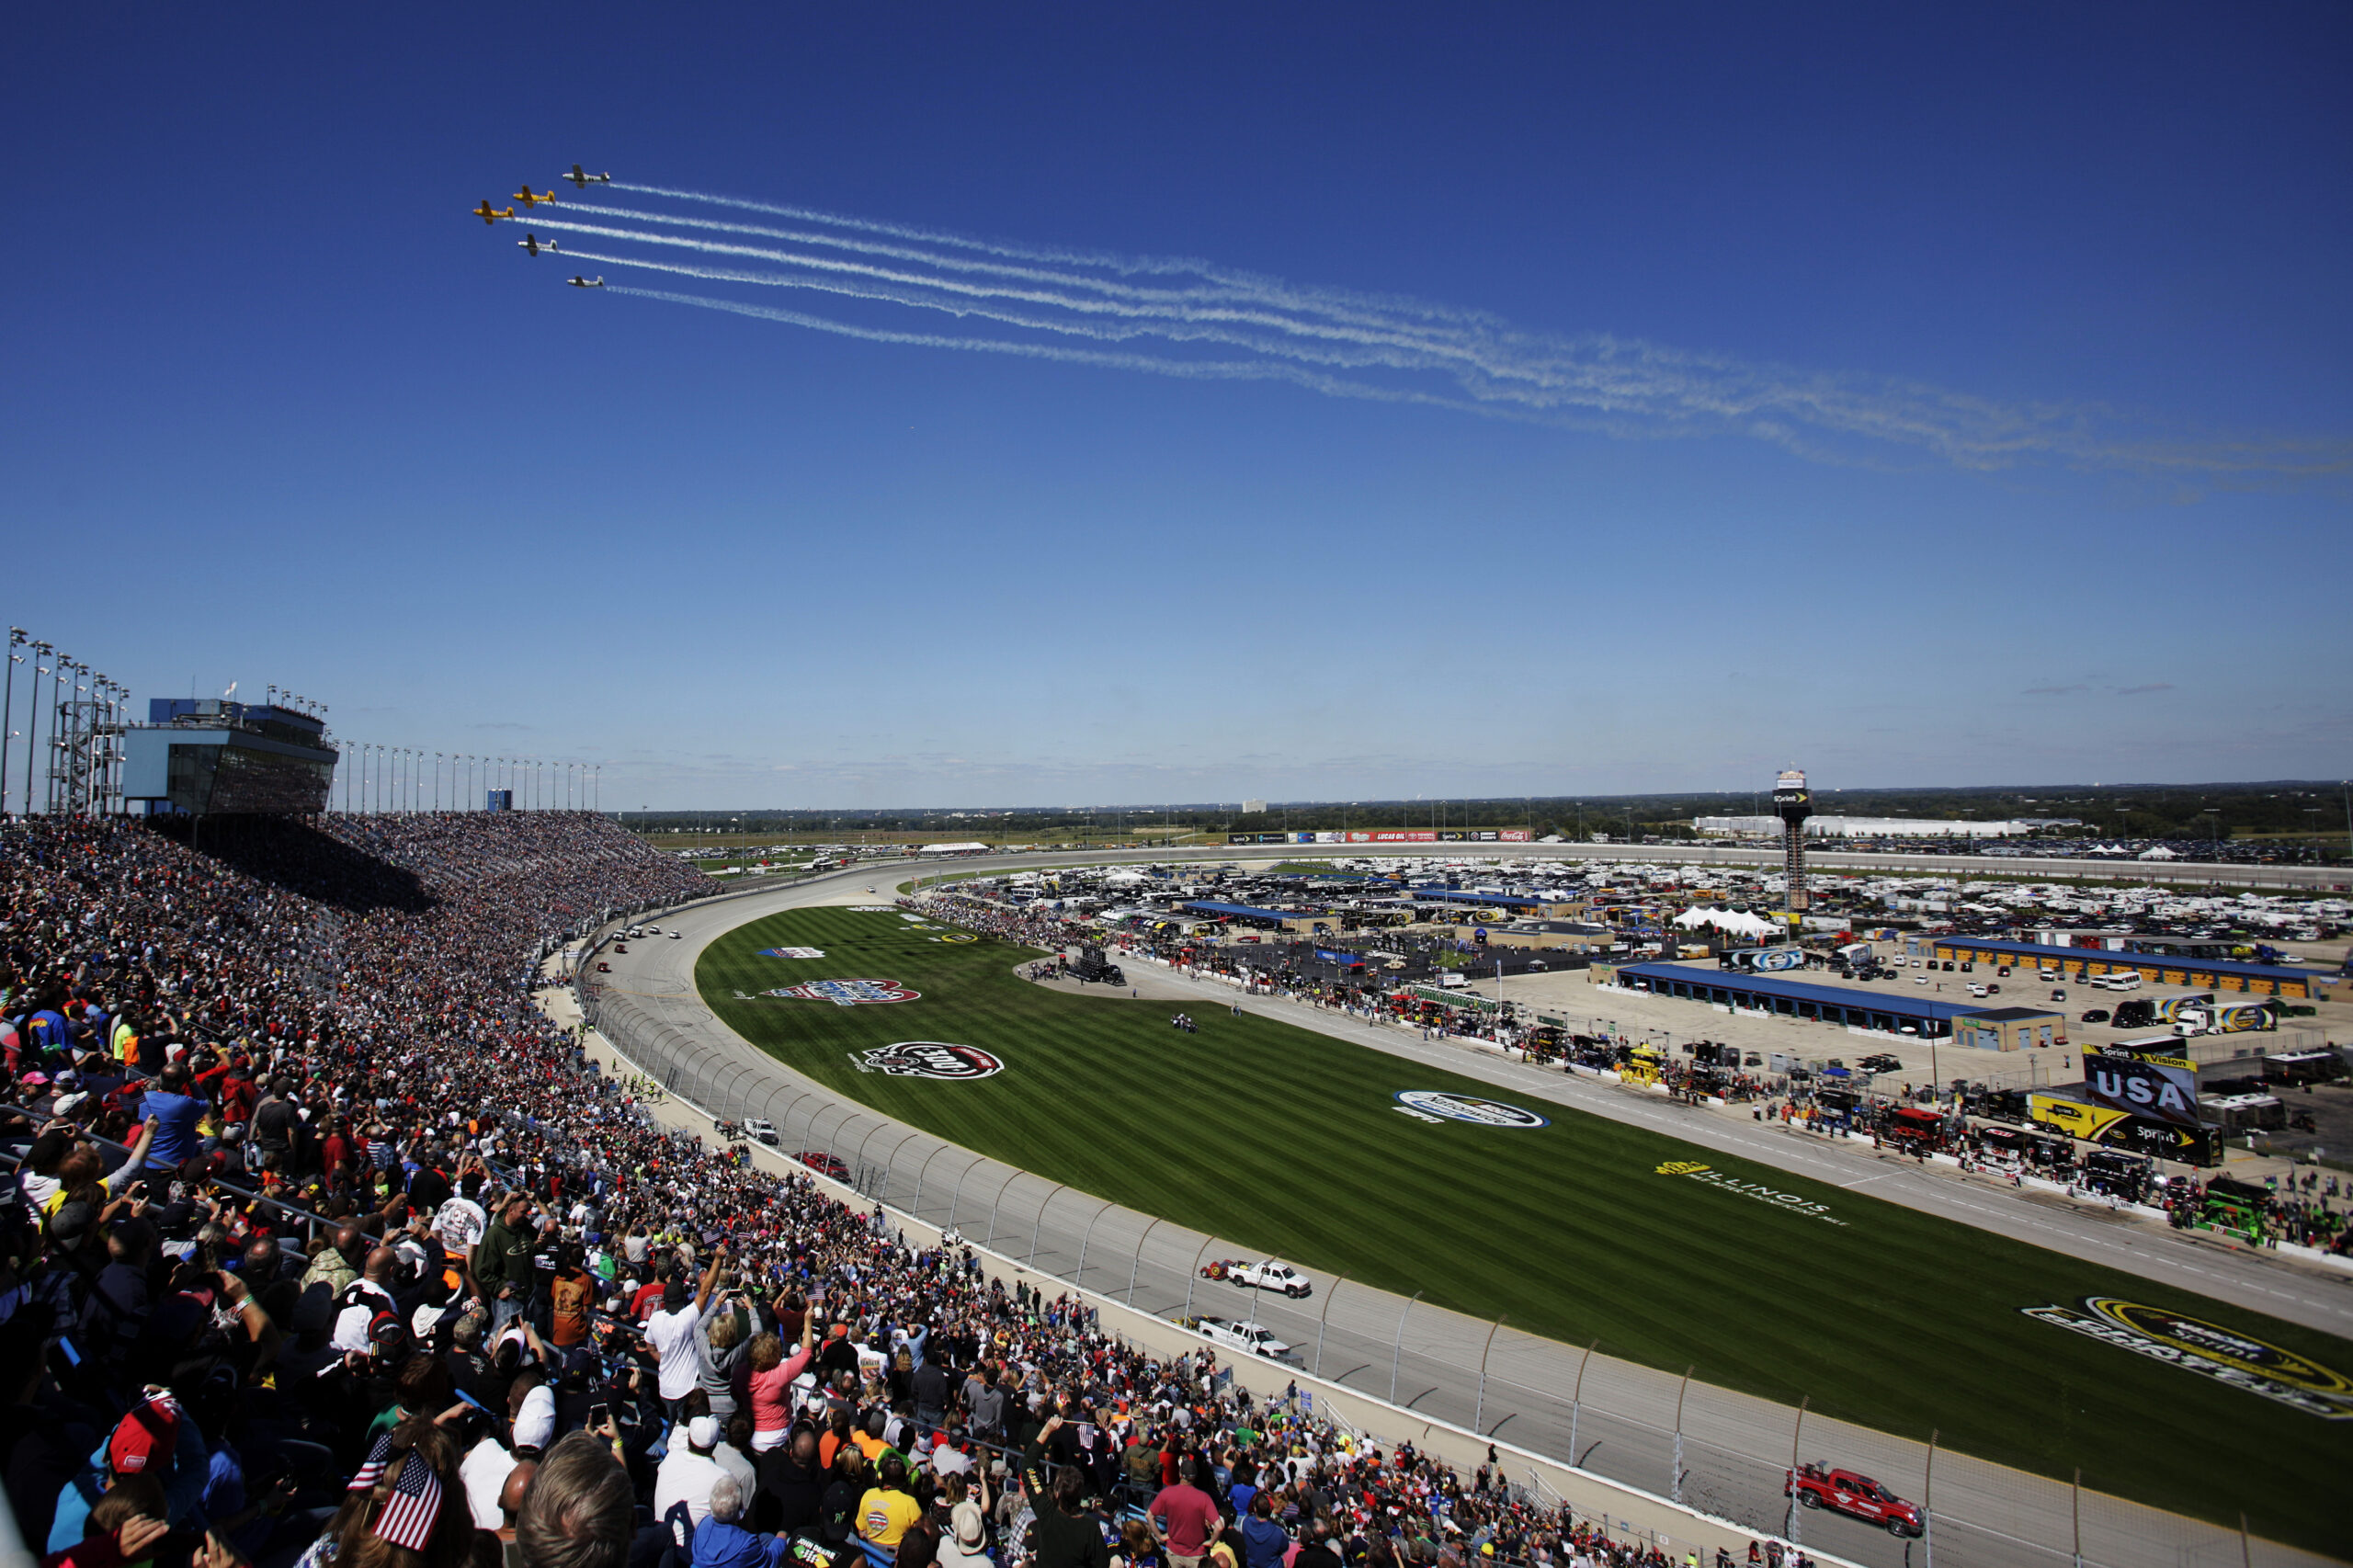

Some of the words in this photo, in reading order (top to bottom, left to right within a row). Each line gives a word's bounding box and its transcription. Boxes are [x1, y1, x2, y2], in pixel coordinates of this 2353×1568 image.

[1774, 794, 1796, 802] Sprint
[913, 1049, 970, 1070] 300
[2102, 1047, 2130, 1059] Sprint
[2150, 1054, 2187, 1068] Vision
[2097, 1071, 2187, 1111] USA
[1425, 1096, 1508, 1125] Nationwide
[2055, 1105, 2074, 1115] Sprint
[2060, 1114, 2080, 1123] Vision
[2137, 1125, 2176, 1143] Sprint
[1699, 1170, 1830, 1212] ILLINOIS
[1710, 1181, 1745, 1194] AFTER
[1744, 1192, 1817, 1217] MAGNIFICENT
[1818, 1215, 1851, 1227] MILE
[2212, 1225, 2224, 1235] 10
[2168, 1328, 2260, 1360] Sprint
[797, 1538, 813, 1549] JOHN
[813, 1544, 836, 1560] DEERE
